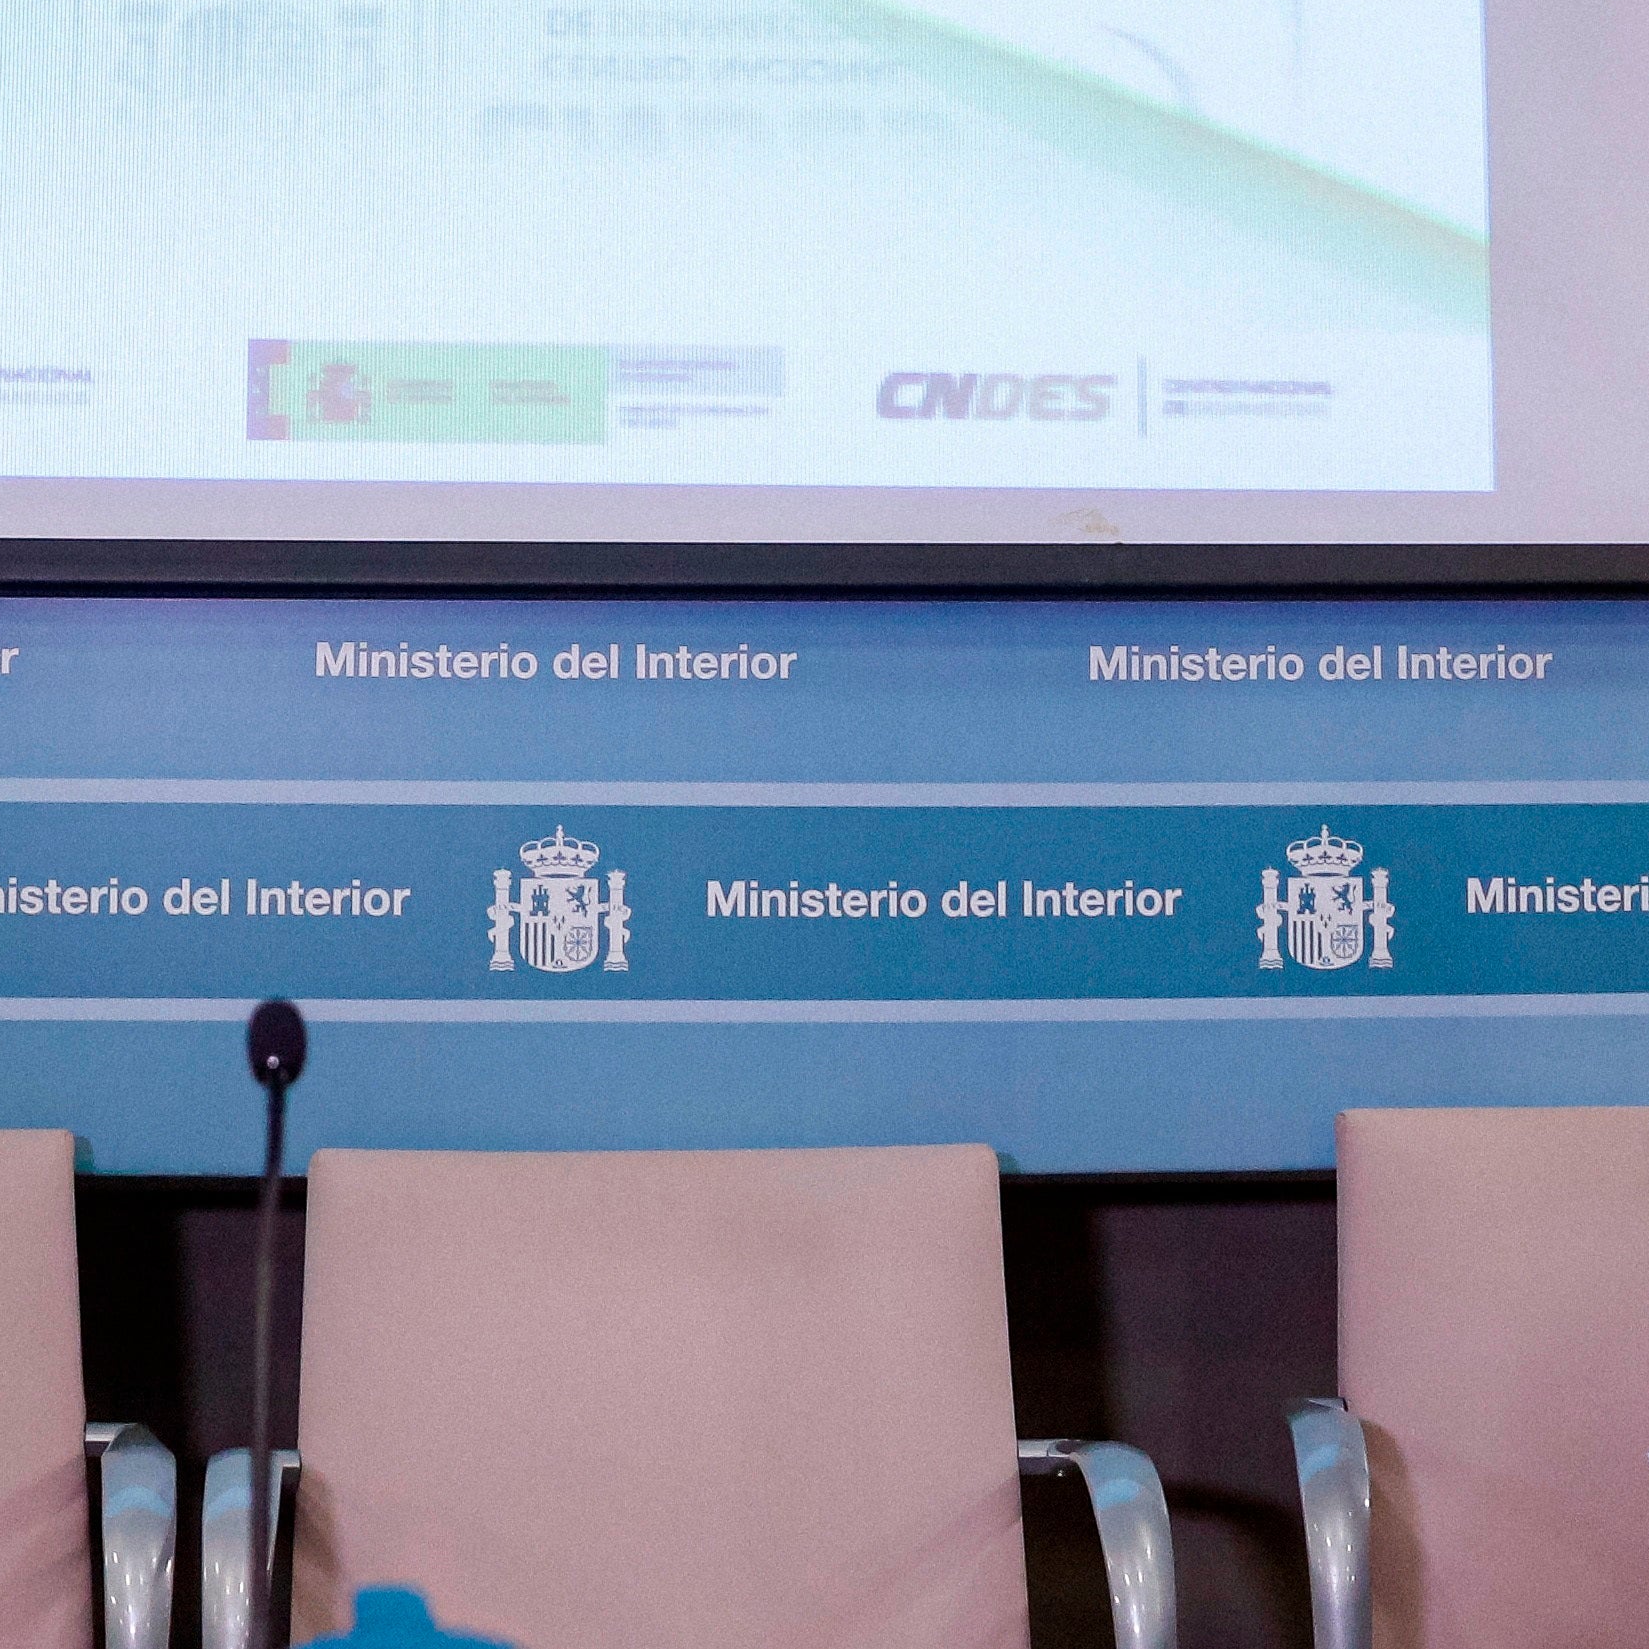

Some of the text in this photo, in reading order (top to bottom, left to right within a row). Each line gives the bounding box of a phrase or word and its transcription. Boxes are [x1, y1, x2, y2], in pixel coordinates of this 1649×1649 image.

[874, 370, 1118, 422] CNDES
[315, 642, 798, 680] Ministerio del Interior
[1089, 644, 1554, 683] Ministerio del Interior
[163, 878, 231, 916] del
[247, 878, 412, 917] Interior
[707, 880, 1184, 919] Ministerio del Interior
